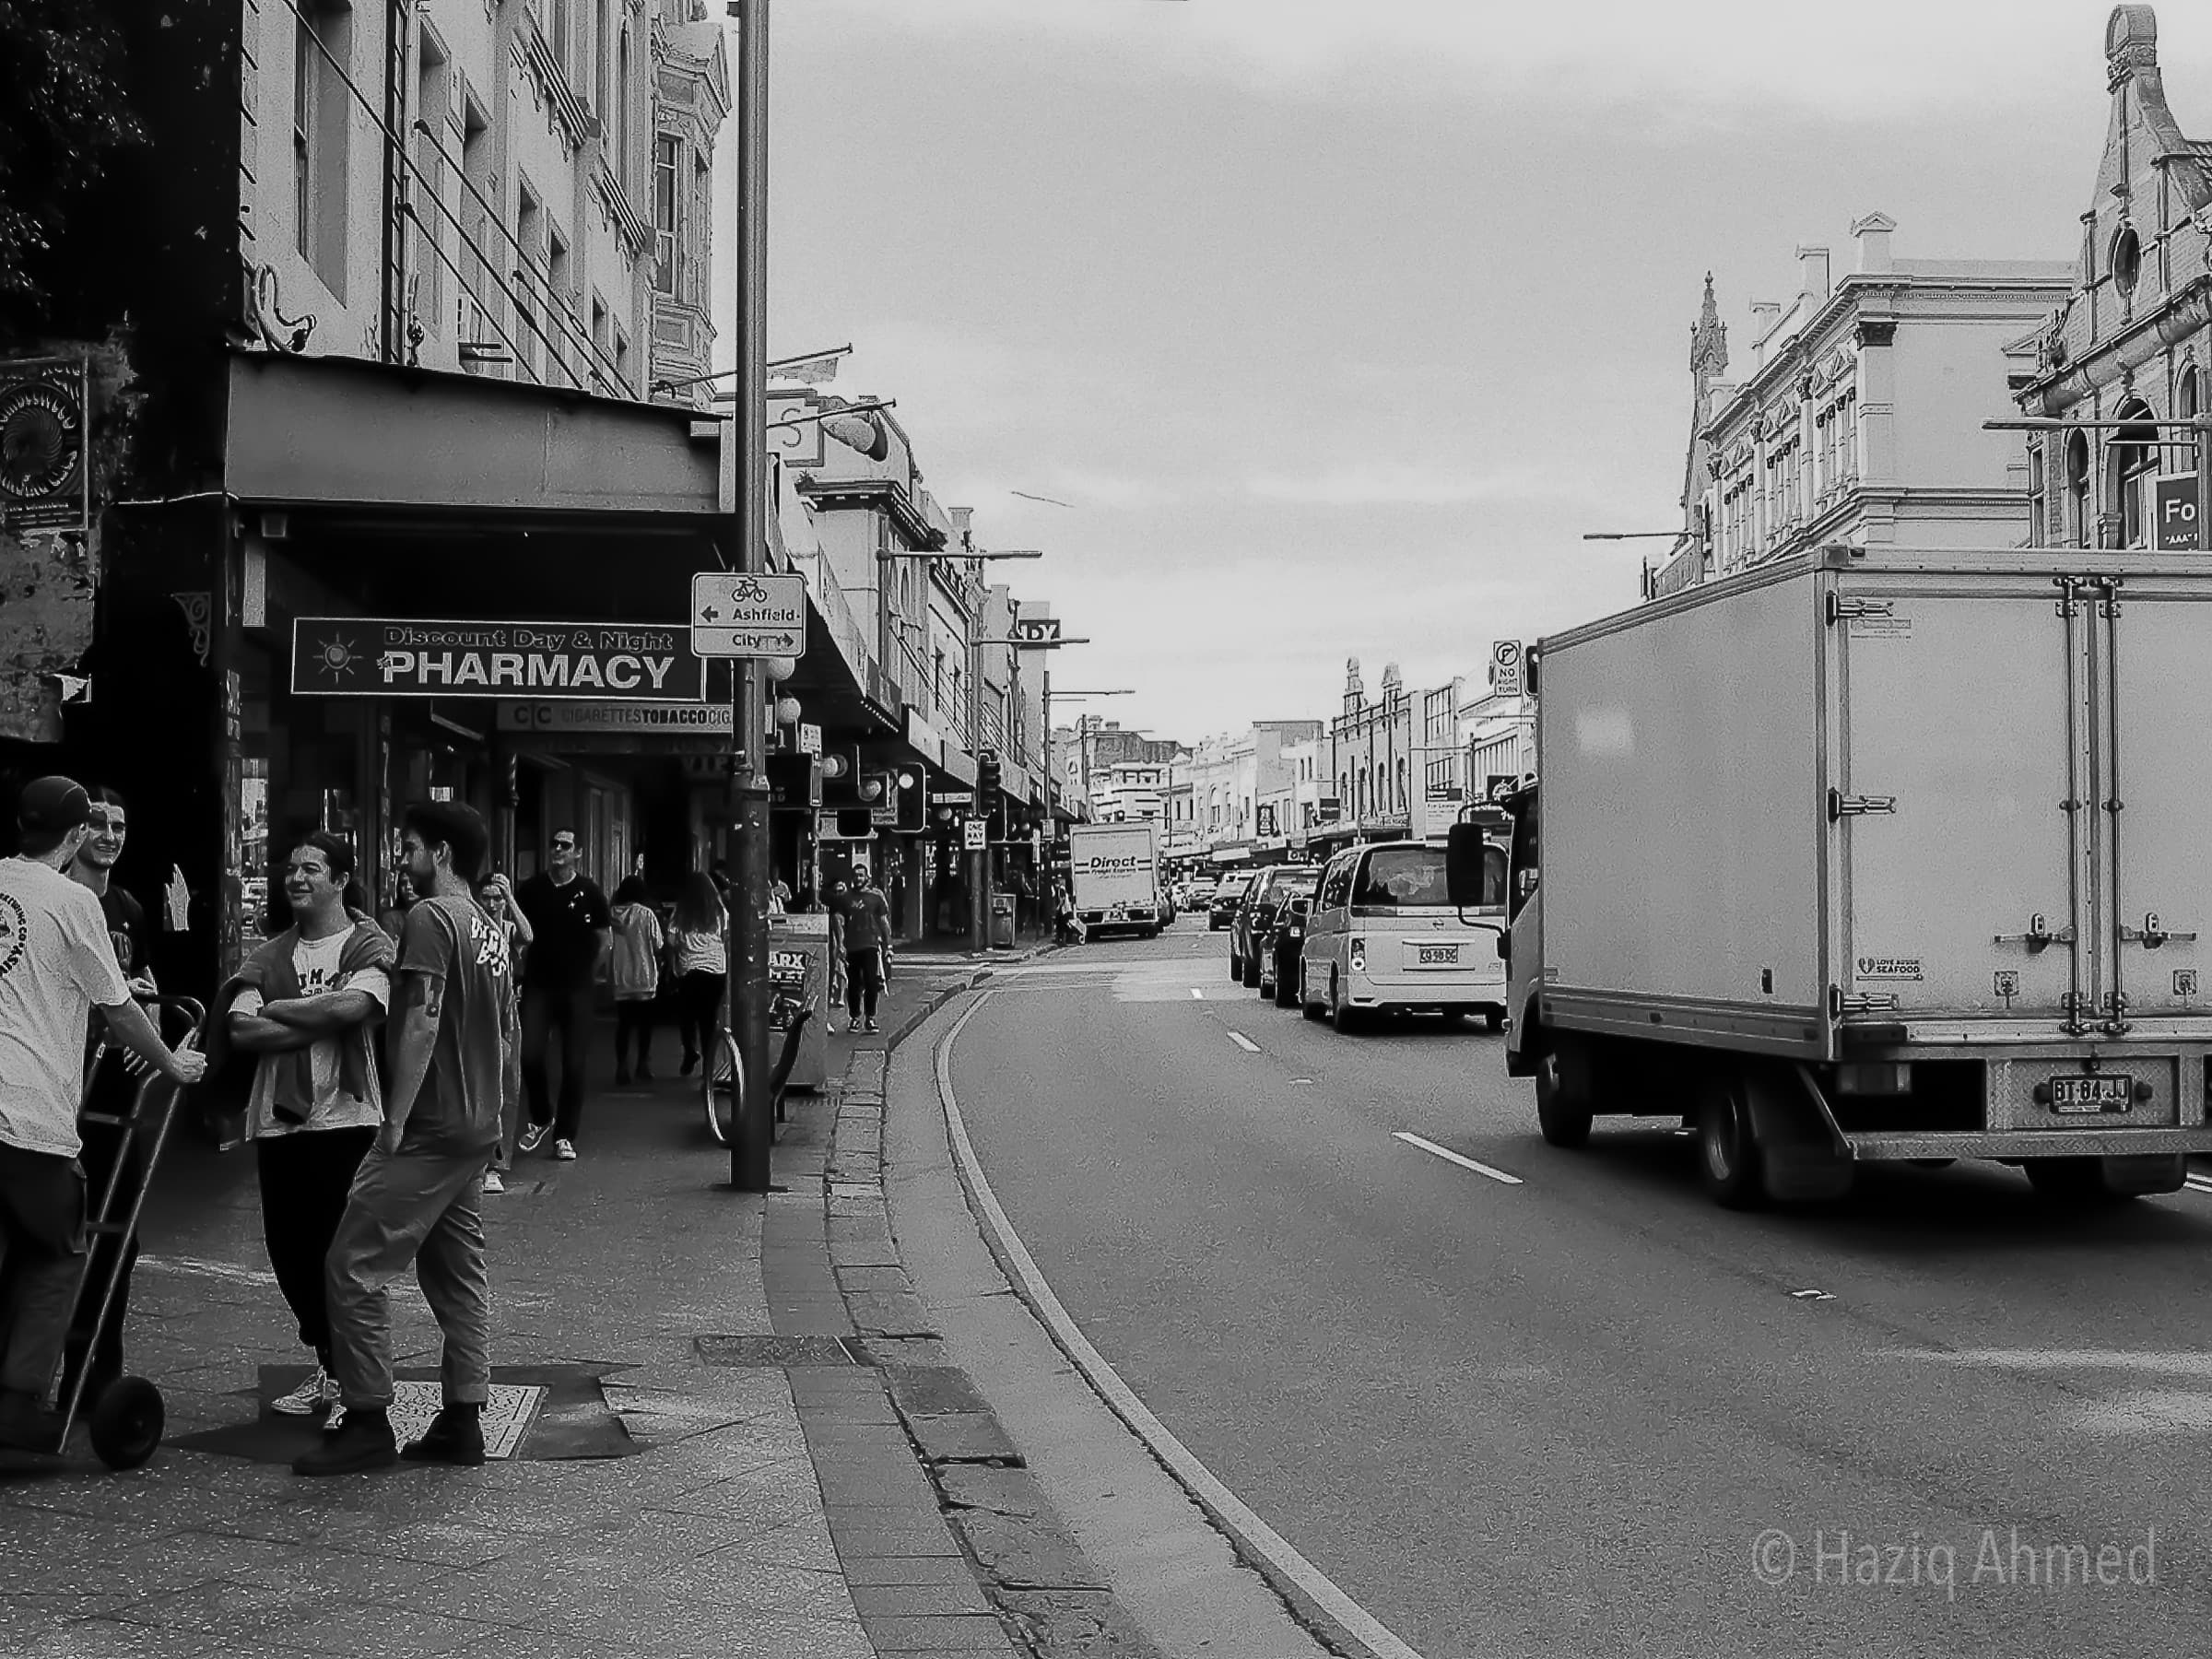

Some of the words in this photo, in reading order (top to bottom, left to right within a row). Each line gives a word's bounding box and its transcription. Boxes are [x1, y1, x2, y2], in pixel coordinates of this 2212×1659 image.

[733, 608, 794, 621] Ashfield
[383, 627, 506, 647] Discount
[513, 629, 566, 652] Day
[571, 630, 594, 650] &
[600, 631, 673, 653] Night
[733, 633, 760, 649] City
[383, 651, 675, 689] PHARMACY
[1500, 668, 1515, 677] NO
[562, 708, 641, 724] CIGARETTES
[642, 710, 706, 725] TOBACCO
[708, 711, 731, 725] CIG
[1090, 855, 1136, 868] Direct
